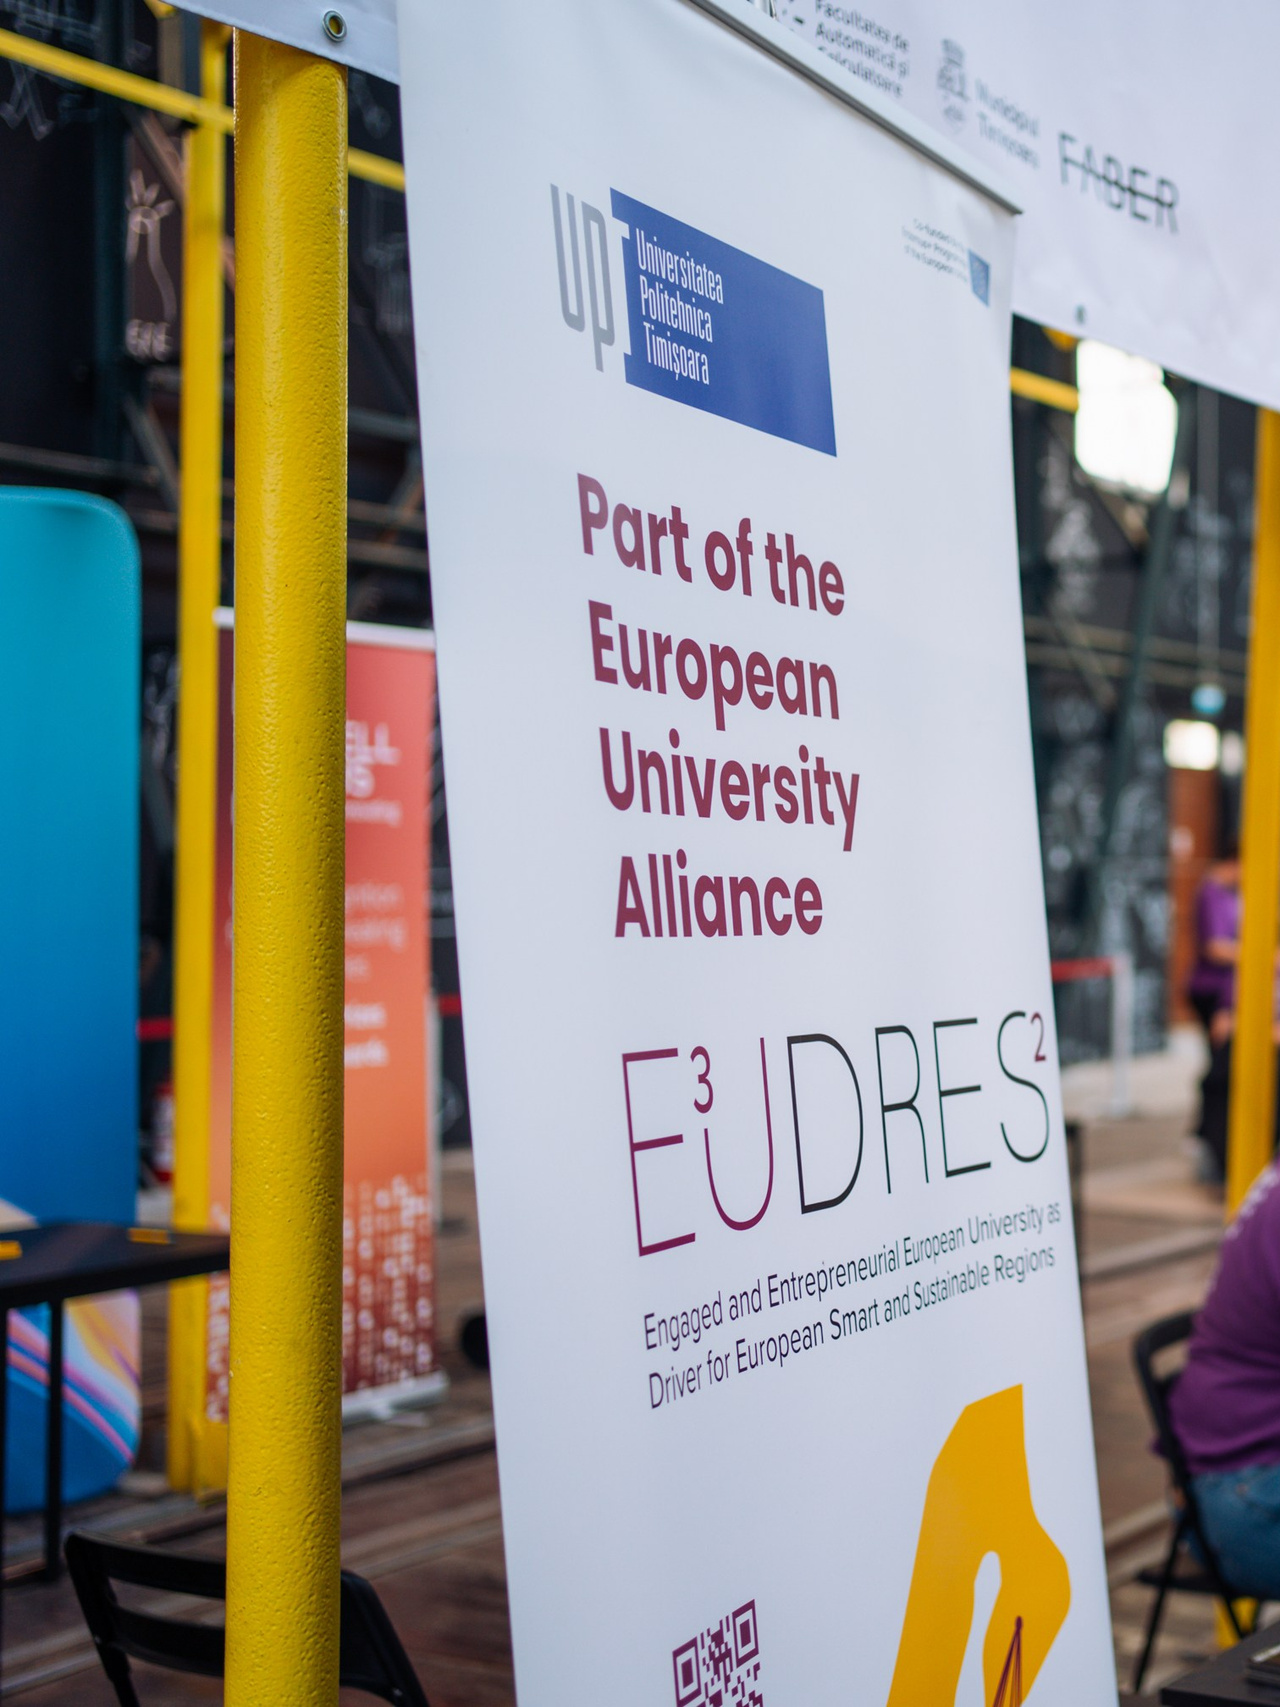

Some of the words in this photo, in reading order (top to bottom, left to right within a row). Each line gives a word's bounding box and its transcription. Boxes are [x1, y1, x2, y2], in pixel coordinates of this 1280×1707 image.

[1058, 131, 1179, 236] FABER
[635, 228, 723, 305] Universitatea
[639, 274, 713, 344] Politehnica
[643, 321, 710, 385] Timișoara
[577, 472, 693, 584] Part
[704, 517, 754, 597] of
[764, 532, 846, 617] the
[588, 599, 840, 731] European
[599, 727, 860, 852] University
[614, 848, 823, 938] Alliance
[643, 1290, 724, 1352] Engaged
[728, 1278, 763, 1321] and
[767, 1240, 900, 1308] Entrepreneurial
[903, 1236, 965, 1266] European
[968, 1203, 1044, 1244] University
[1047, 1202, 1062, 1224] as
[648, 1363, 702, 1409] Driver
[707, 1349, 731, 1385] for
[735, 1320, 825, 1374] European
[829, 1299, 880, 1340] Smart
[884, 1285, 911, 1323] and
[913, 1260, 990, 1311] Sustainable
[993, 1246, 1056, 1283] Regions
